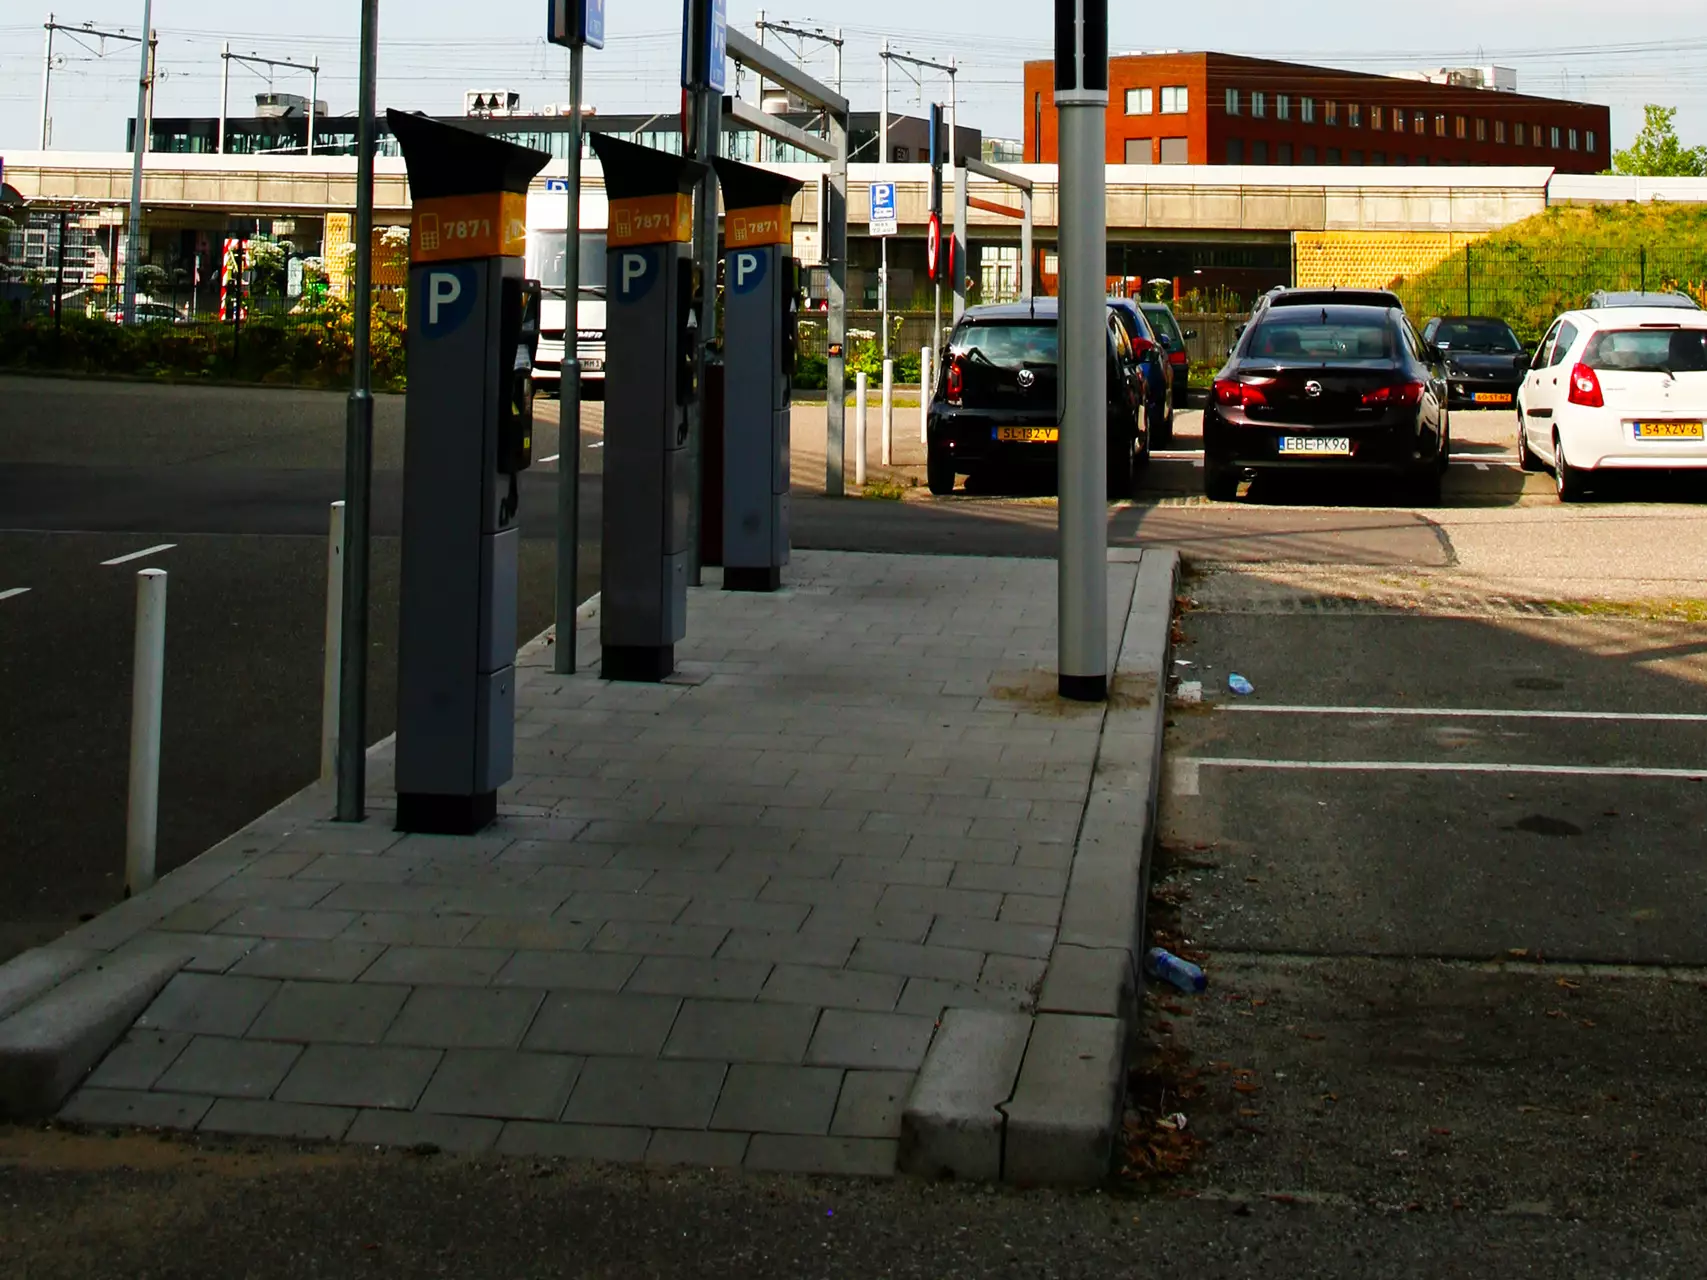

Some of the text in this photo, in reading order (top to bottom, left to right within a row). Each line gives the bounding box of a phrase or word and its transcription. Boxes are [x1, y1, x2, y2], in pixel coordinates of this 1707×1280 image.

[634, 214, 670, 229] 7871
[749, 221, 778, 233] 7871
[443, 220, 490, 239] 7871
[623, 254, 647, 293] P
[738, 254, 757, 285] P
[429, 273, 461, 324] P
[1003, 428, 1052, 438] SL-132-V
[1645, 423, 1698, 435] 54-XZV-6
[1316, 439, 1347, 450] PK96
